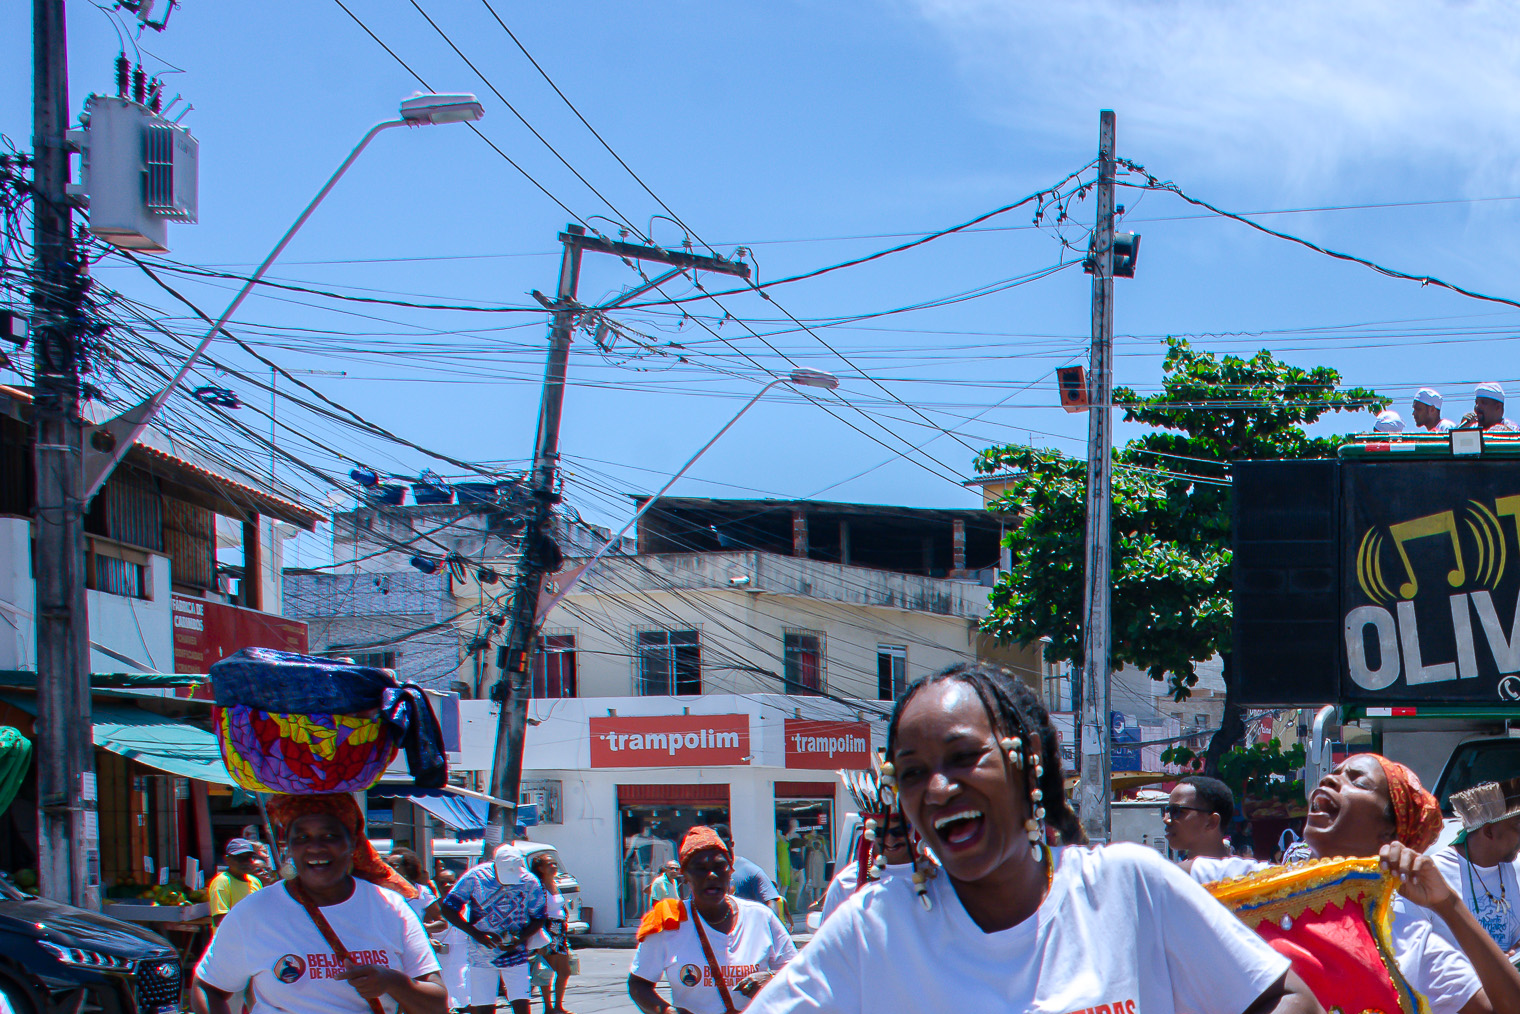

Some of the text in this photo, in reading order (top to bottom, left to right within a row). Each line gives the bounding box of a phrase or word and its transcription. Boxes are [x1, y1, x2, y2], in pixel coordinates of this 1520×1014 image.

[607, 729, 739, 755] trampolim
[795, 733, 866, 758] trampolim
[309, 968, 323, 980] DE
